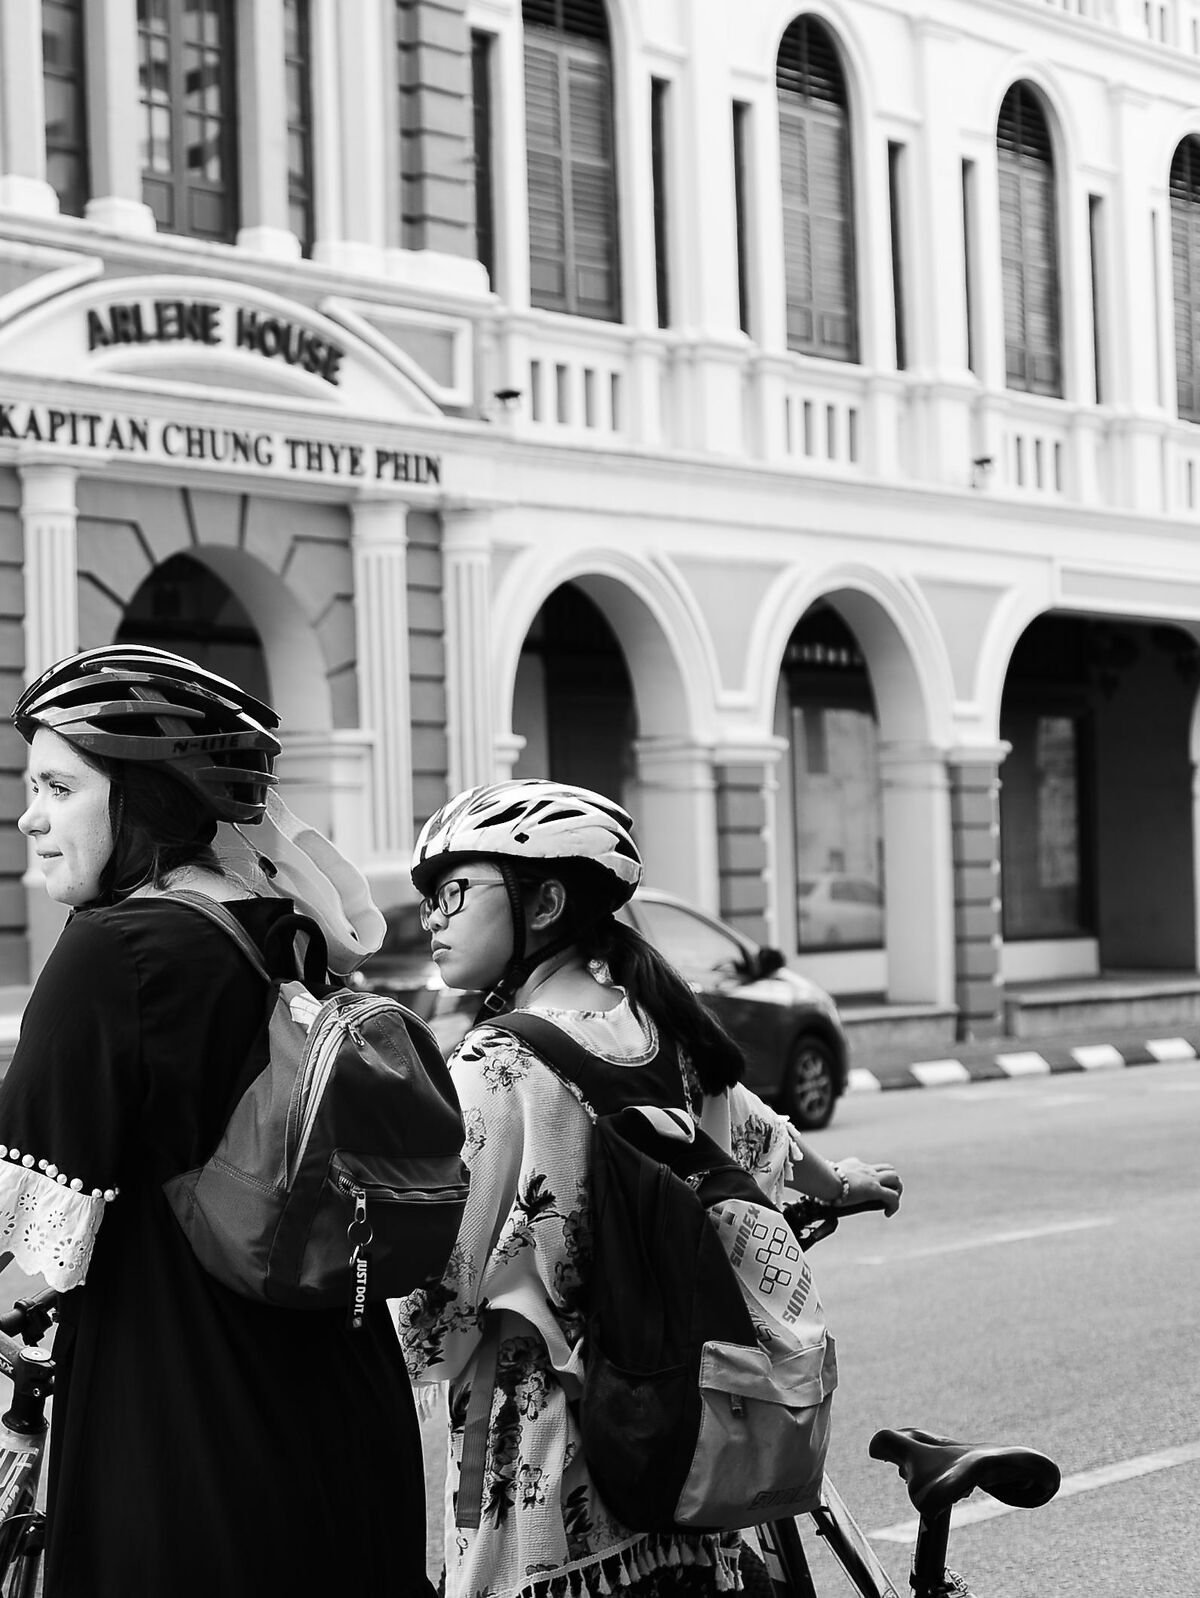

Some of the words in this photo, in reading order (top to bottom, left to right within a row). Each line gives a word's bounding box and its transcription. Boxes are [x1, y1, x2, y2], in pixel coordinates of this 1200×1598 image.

[86, 301, 222, 352] ARLENE
[236, 308, 345, 387] HOUSE
[161, 423, 274, 468] CHUNG
[284, 438, 365, 477] THYE
[374, 449, 441, 484] PHIN
[355, 1286, 366, 1303] DO
[356, 1258, 367, 1285] JUST
[782, 1260, 811, 1324] SUNNE
